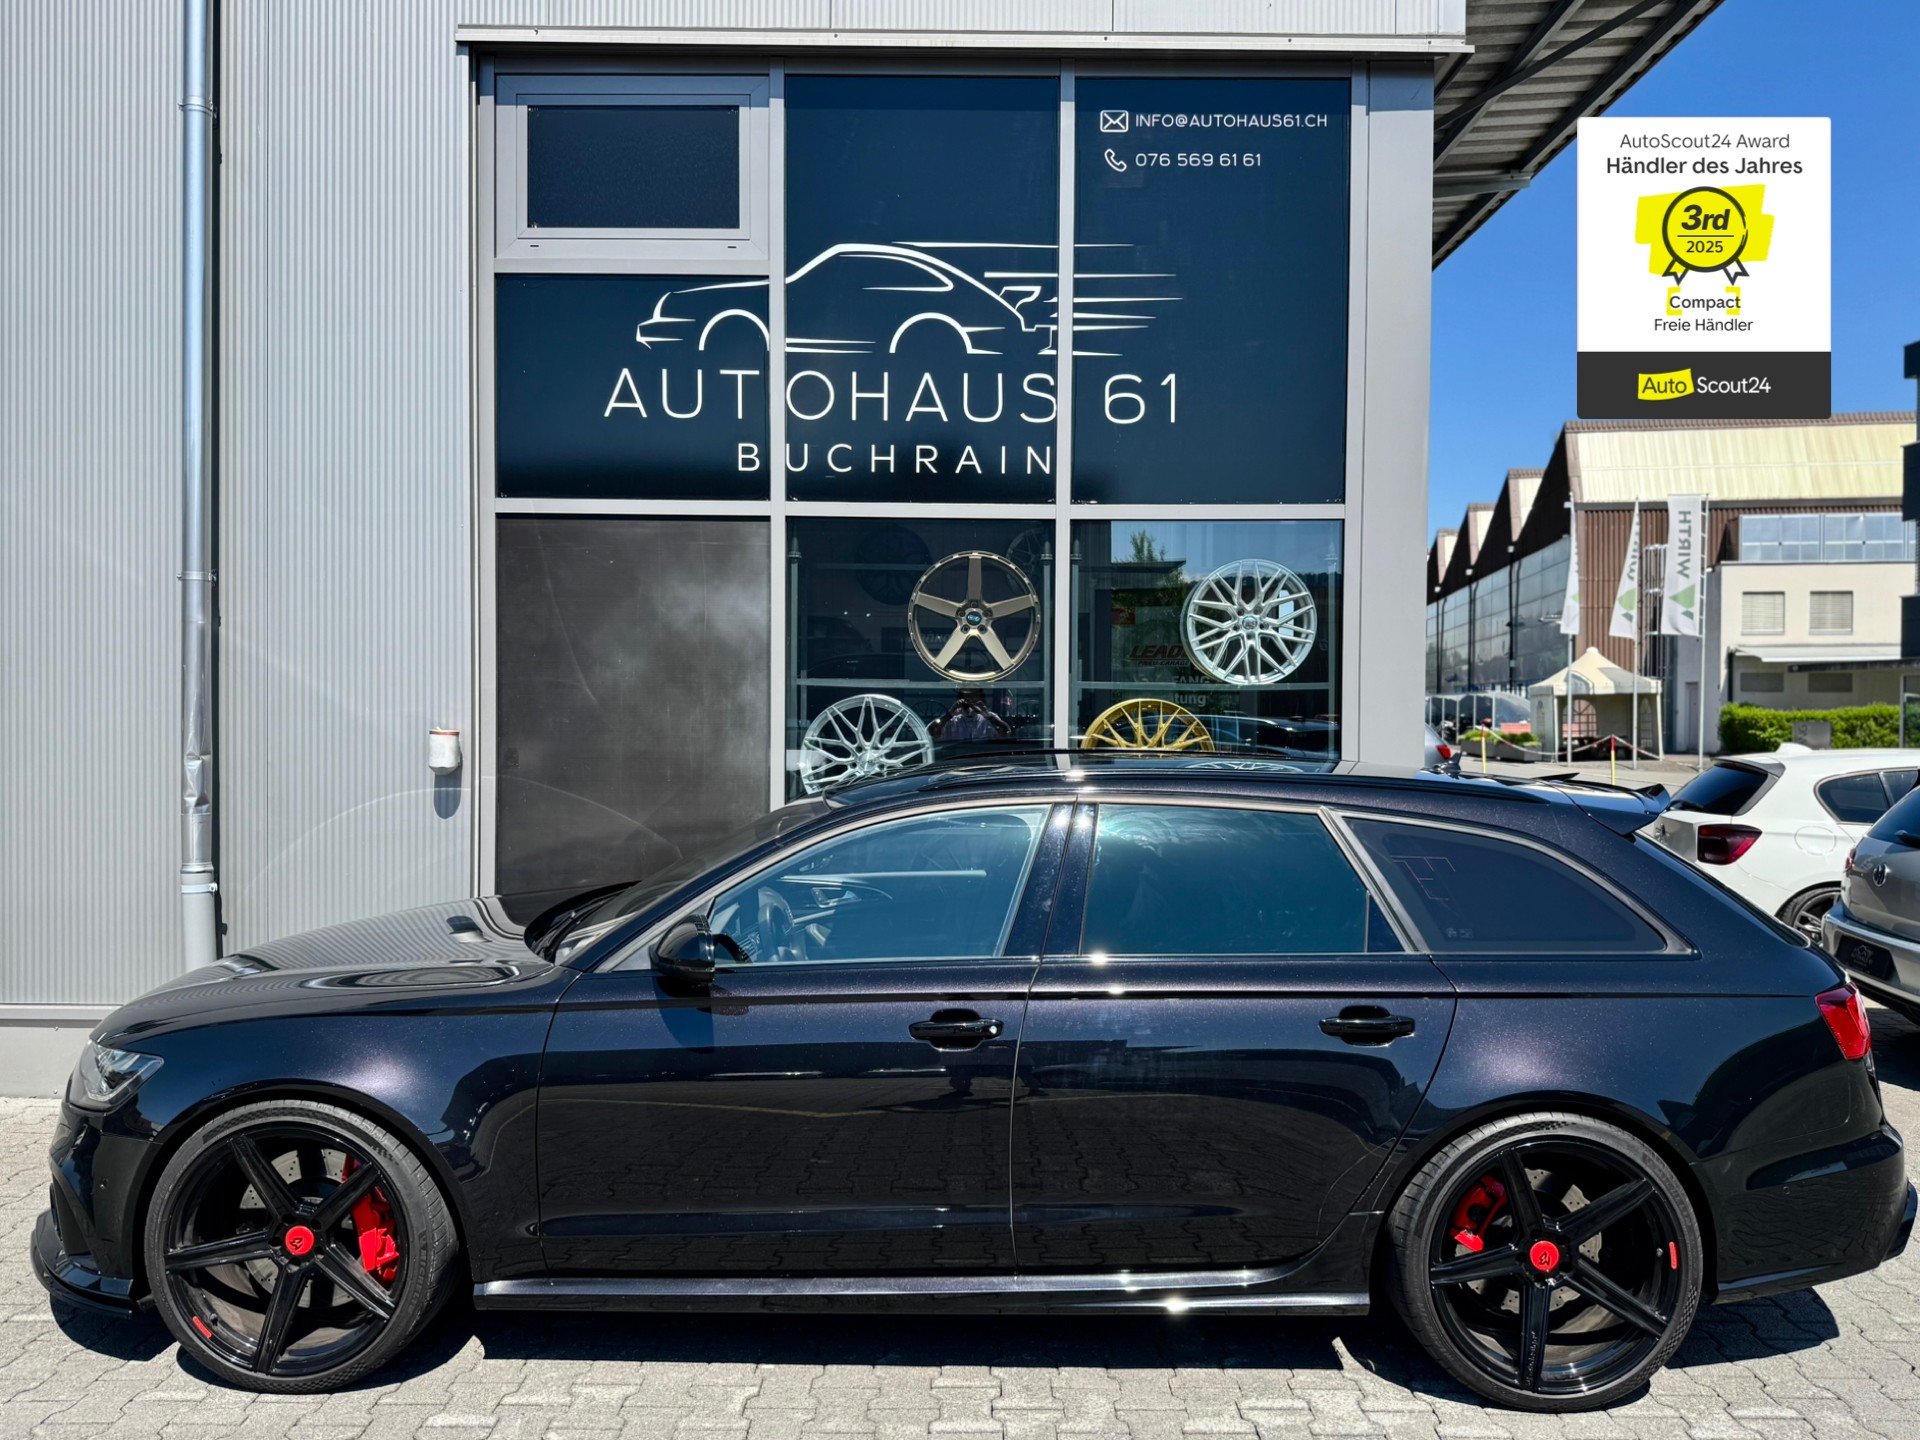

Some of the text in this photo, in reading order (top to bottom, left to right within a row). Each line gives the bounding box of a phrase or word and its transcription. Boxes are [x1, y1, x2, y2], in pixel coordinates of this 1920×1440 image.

[1135, 113, 1328, 128] INFO@AUTOHAUS61.CH
[1135, 153, 1261, 167] 076 569 61 61
[603, 367, 1176, 425] AUTOHAUS 61
[738, 442, 1052, 475] BUCHRAIN
